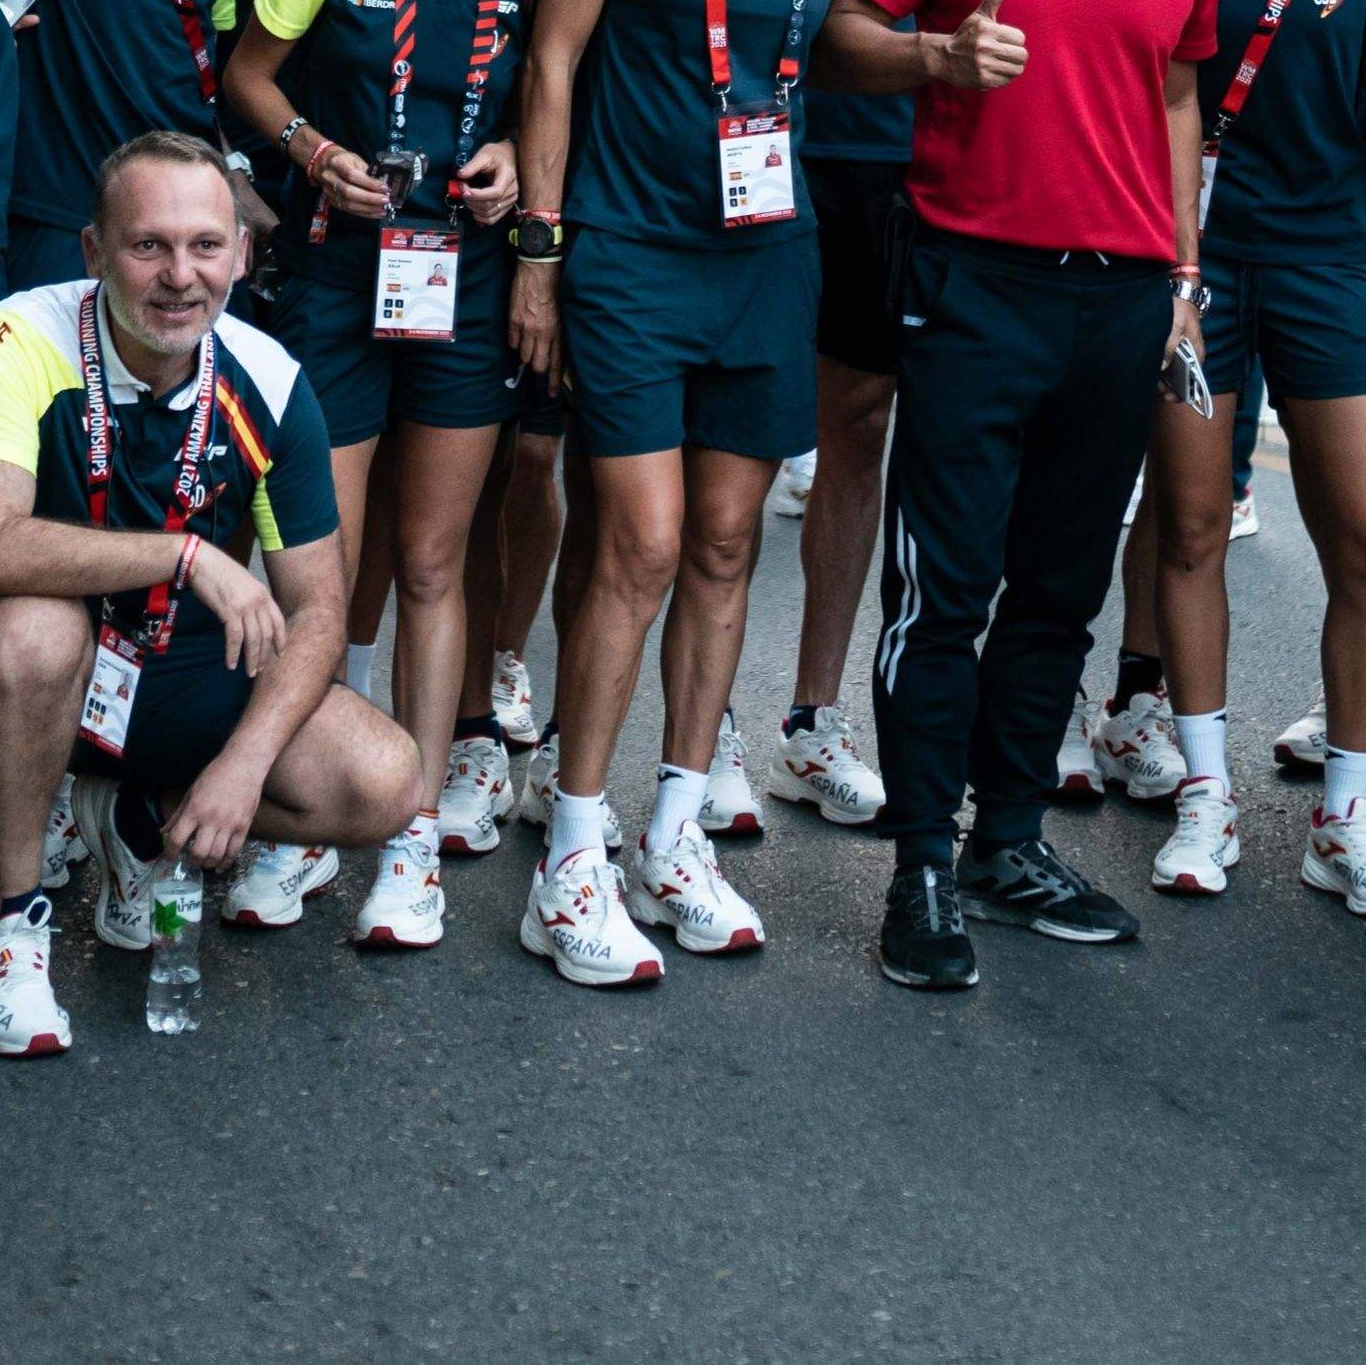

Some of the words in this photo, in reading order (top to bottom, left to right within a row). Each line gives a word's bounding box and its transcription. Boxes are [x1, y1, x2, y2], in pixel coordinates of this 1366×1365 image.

[497, 0, 518, 14] SP
[80, 298, 98, 363] RUNNING
[85, 363, 107, 477] CHAMPIONSHIPS
[176, 465, 196, 496] 2021
[186, 397, 210, 463] AMAZING
[811, 775, 858, 805] ESPAÑA
[552, 928, 611, 960] ESPAÑA
